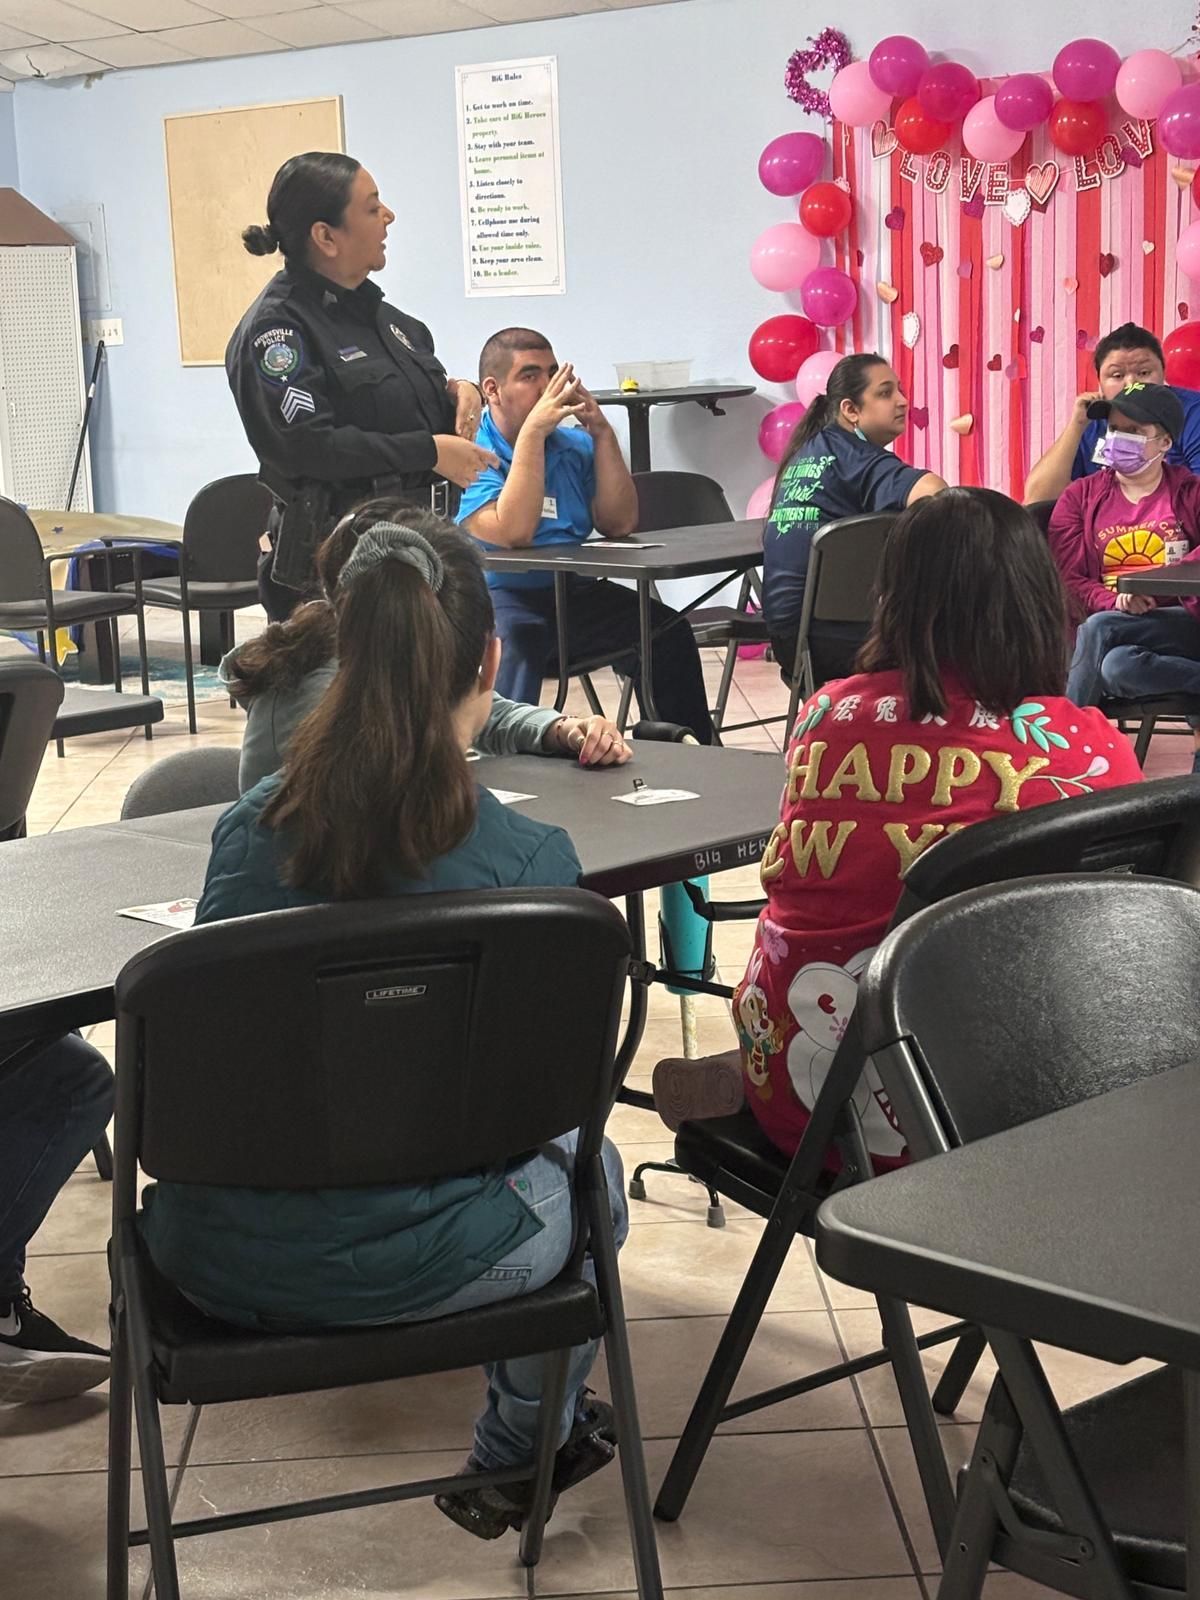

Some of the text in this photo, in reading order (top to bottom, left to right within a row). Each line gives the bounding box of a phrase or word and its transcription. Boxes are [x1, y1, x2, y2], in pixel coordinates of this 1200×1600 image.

[493, 153, 518, 162] personal
[1074, 118, 1153, 191] LOV
[900, 150, 1009, 205] LOVE
[478, 219, 506, 227] Cellphone
[520, 216, 540, 224] during
[262, 335, 286, 348] POLICE
[1098, 520, 1156, 540] SUMMER
[788, 741, 1050, 812] HAPPY
[694, 838, 767, 871] BIG HER
[760, 819, 857, 881] EW
